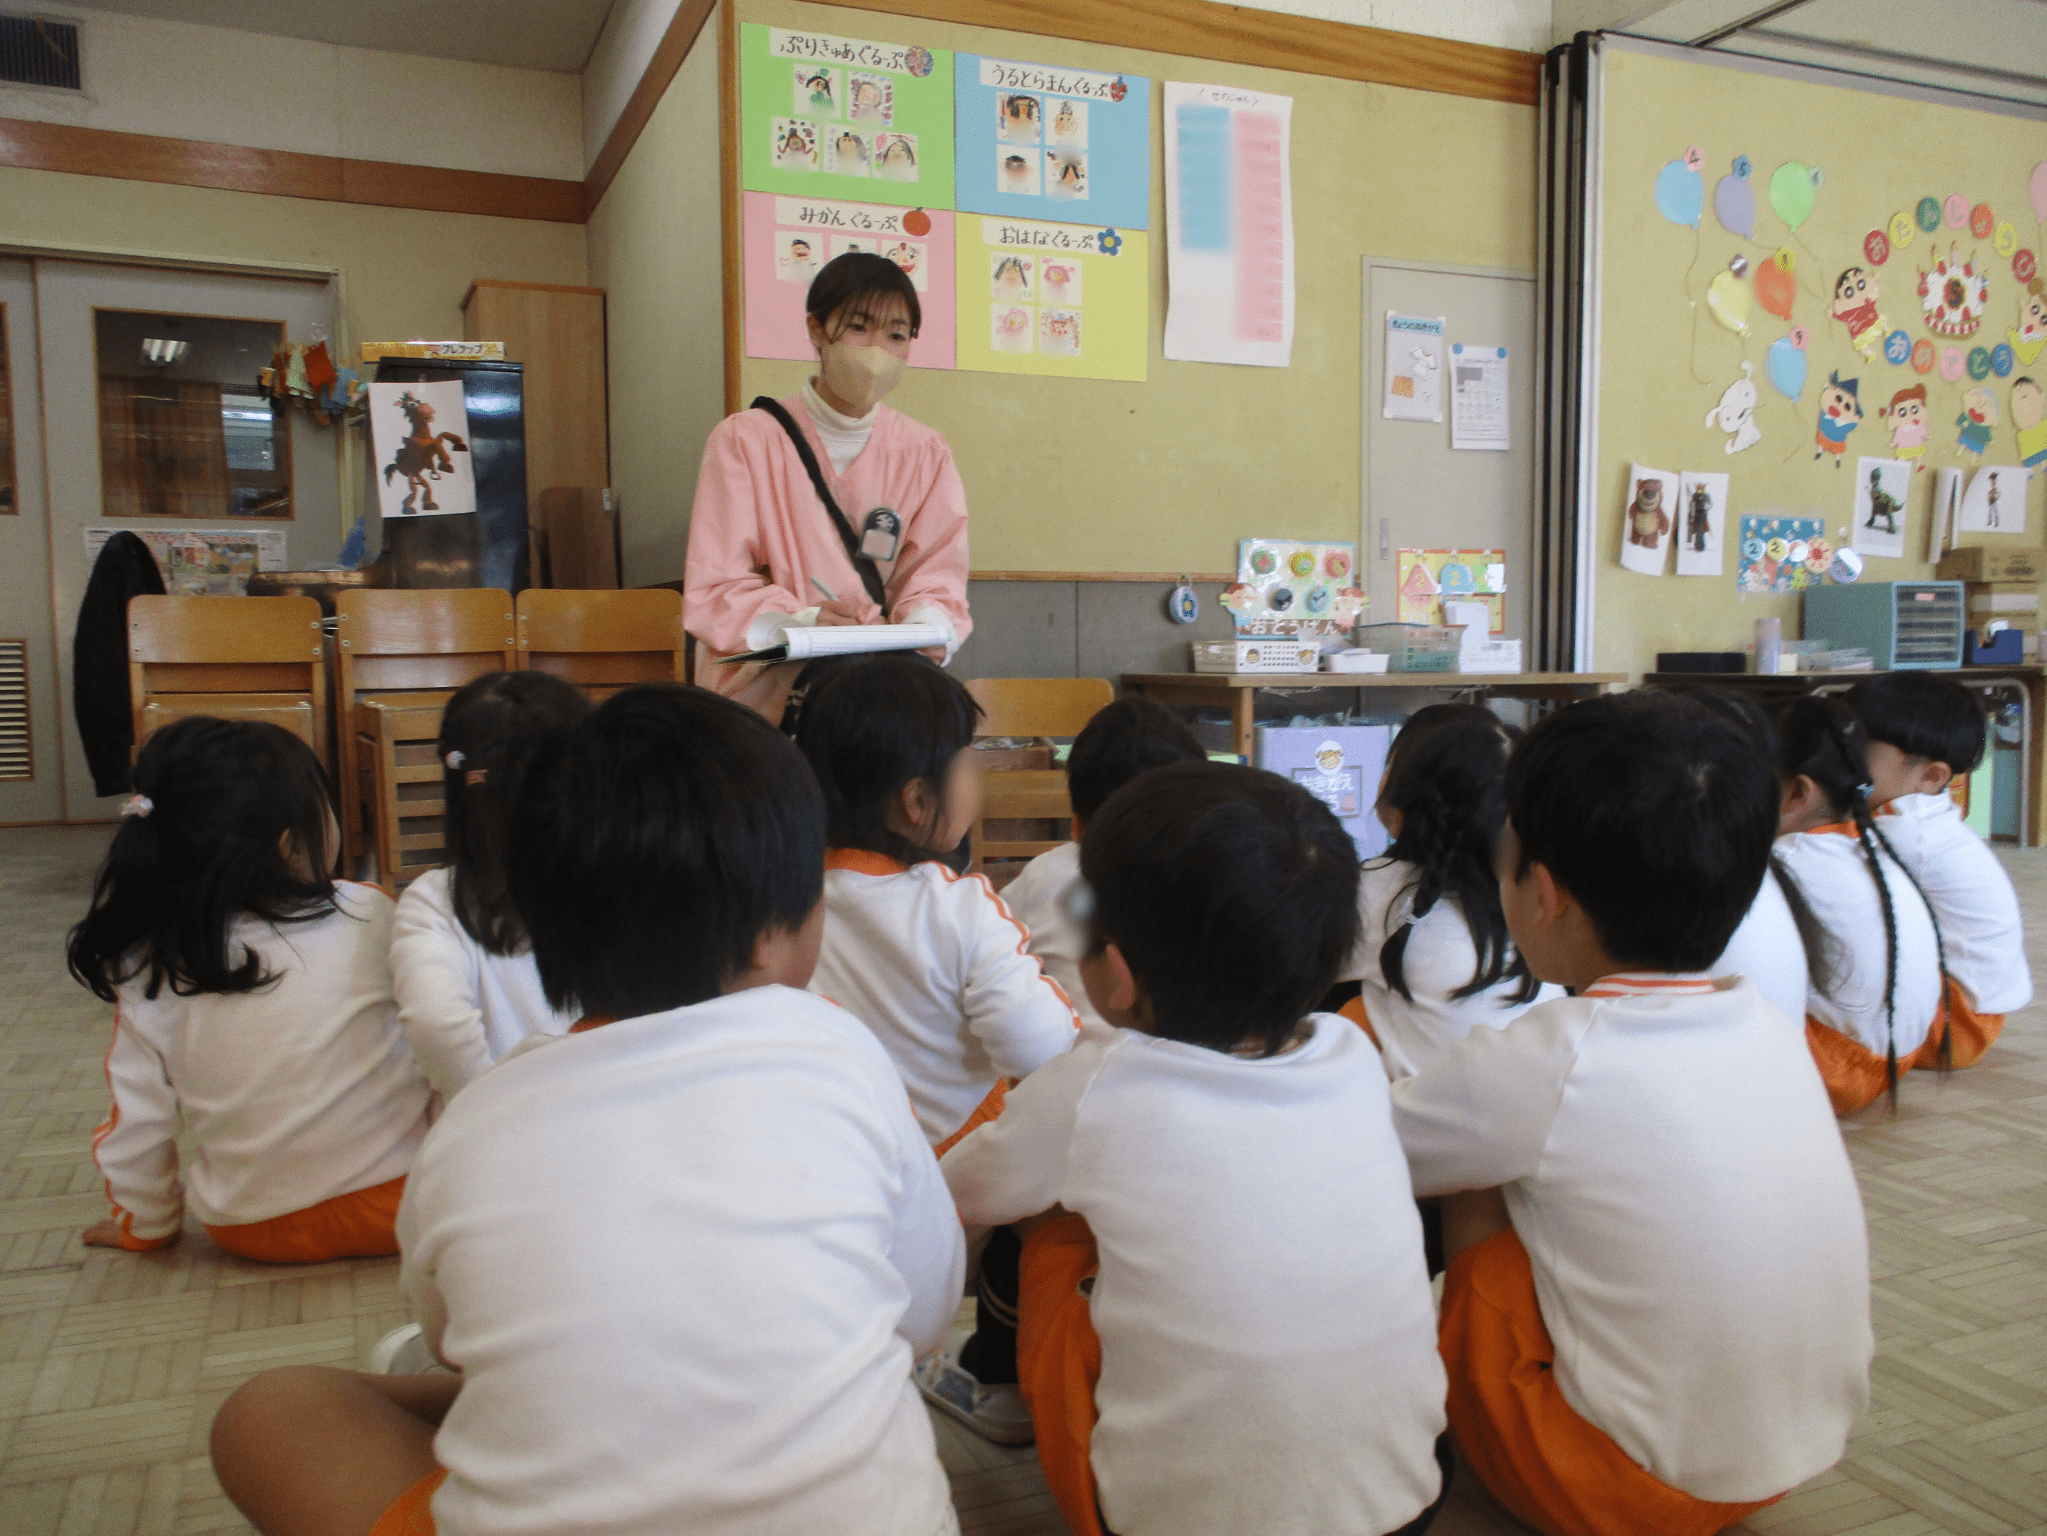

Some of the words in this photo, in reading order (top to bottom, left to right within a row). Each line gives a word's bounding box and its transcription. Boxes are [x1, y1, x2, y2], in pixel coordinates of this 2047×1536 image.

[780, 36, 904, 70] ぷりきゅあぐるーぷ
[992, 64, 1108, 98] うるとらまんぐるーぷ
[799, 206, 898, 233] みかんぐるーぷ
[1000, 226, 1094, 249] おはなぐるーぷ
[1448, 570, 1461, 586] 2
